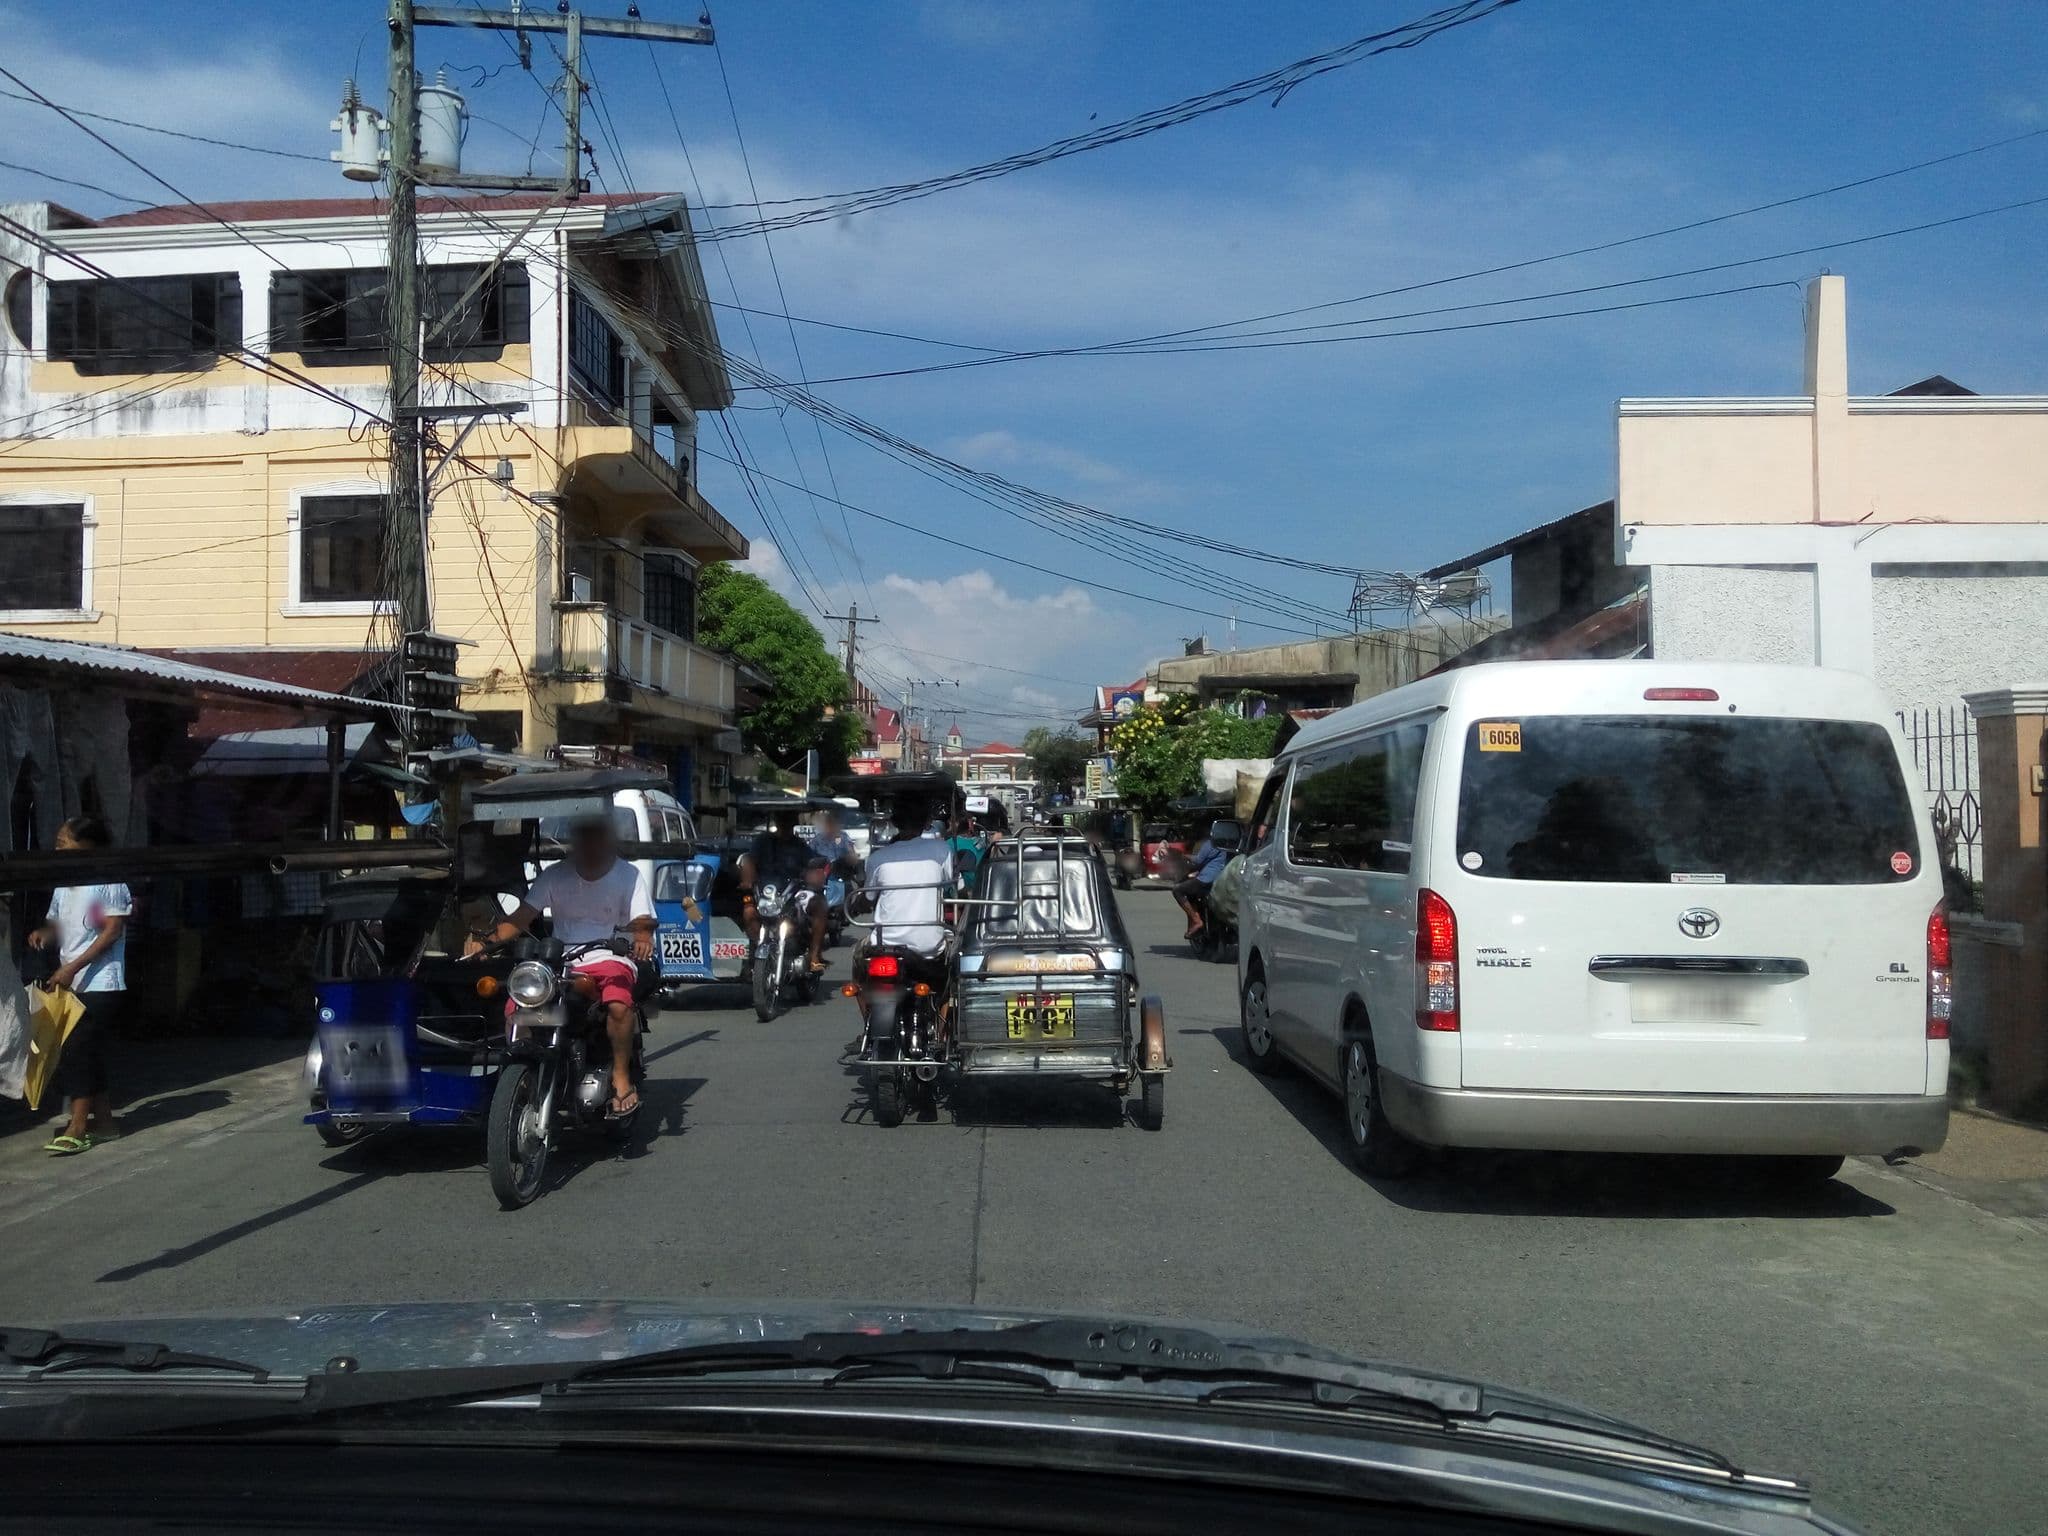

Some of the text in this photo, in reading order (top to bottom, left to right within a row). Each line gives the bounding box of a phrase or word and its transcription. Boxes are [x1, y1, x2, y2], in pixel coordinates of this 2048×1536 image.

[1489, 730, 1520, 745] 6058
[663, 940, 701, 958] 2266
[714, 943, 746, 956] 2266
[1476, 958, 1532, 968] HIACE
[1889, 962, 1909, 973] GL
[1875, 975, 1920, 983] Grandia
